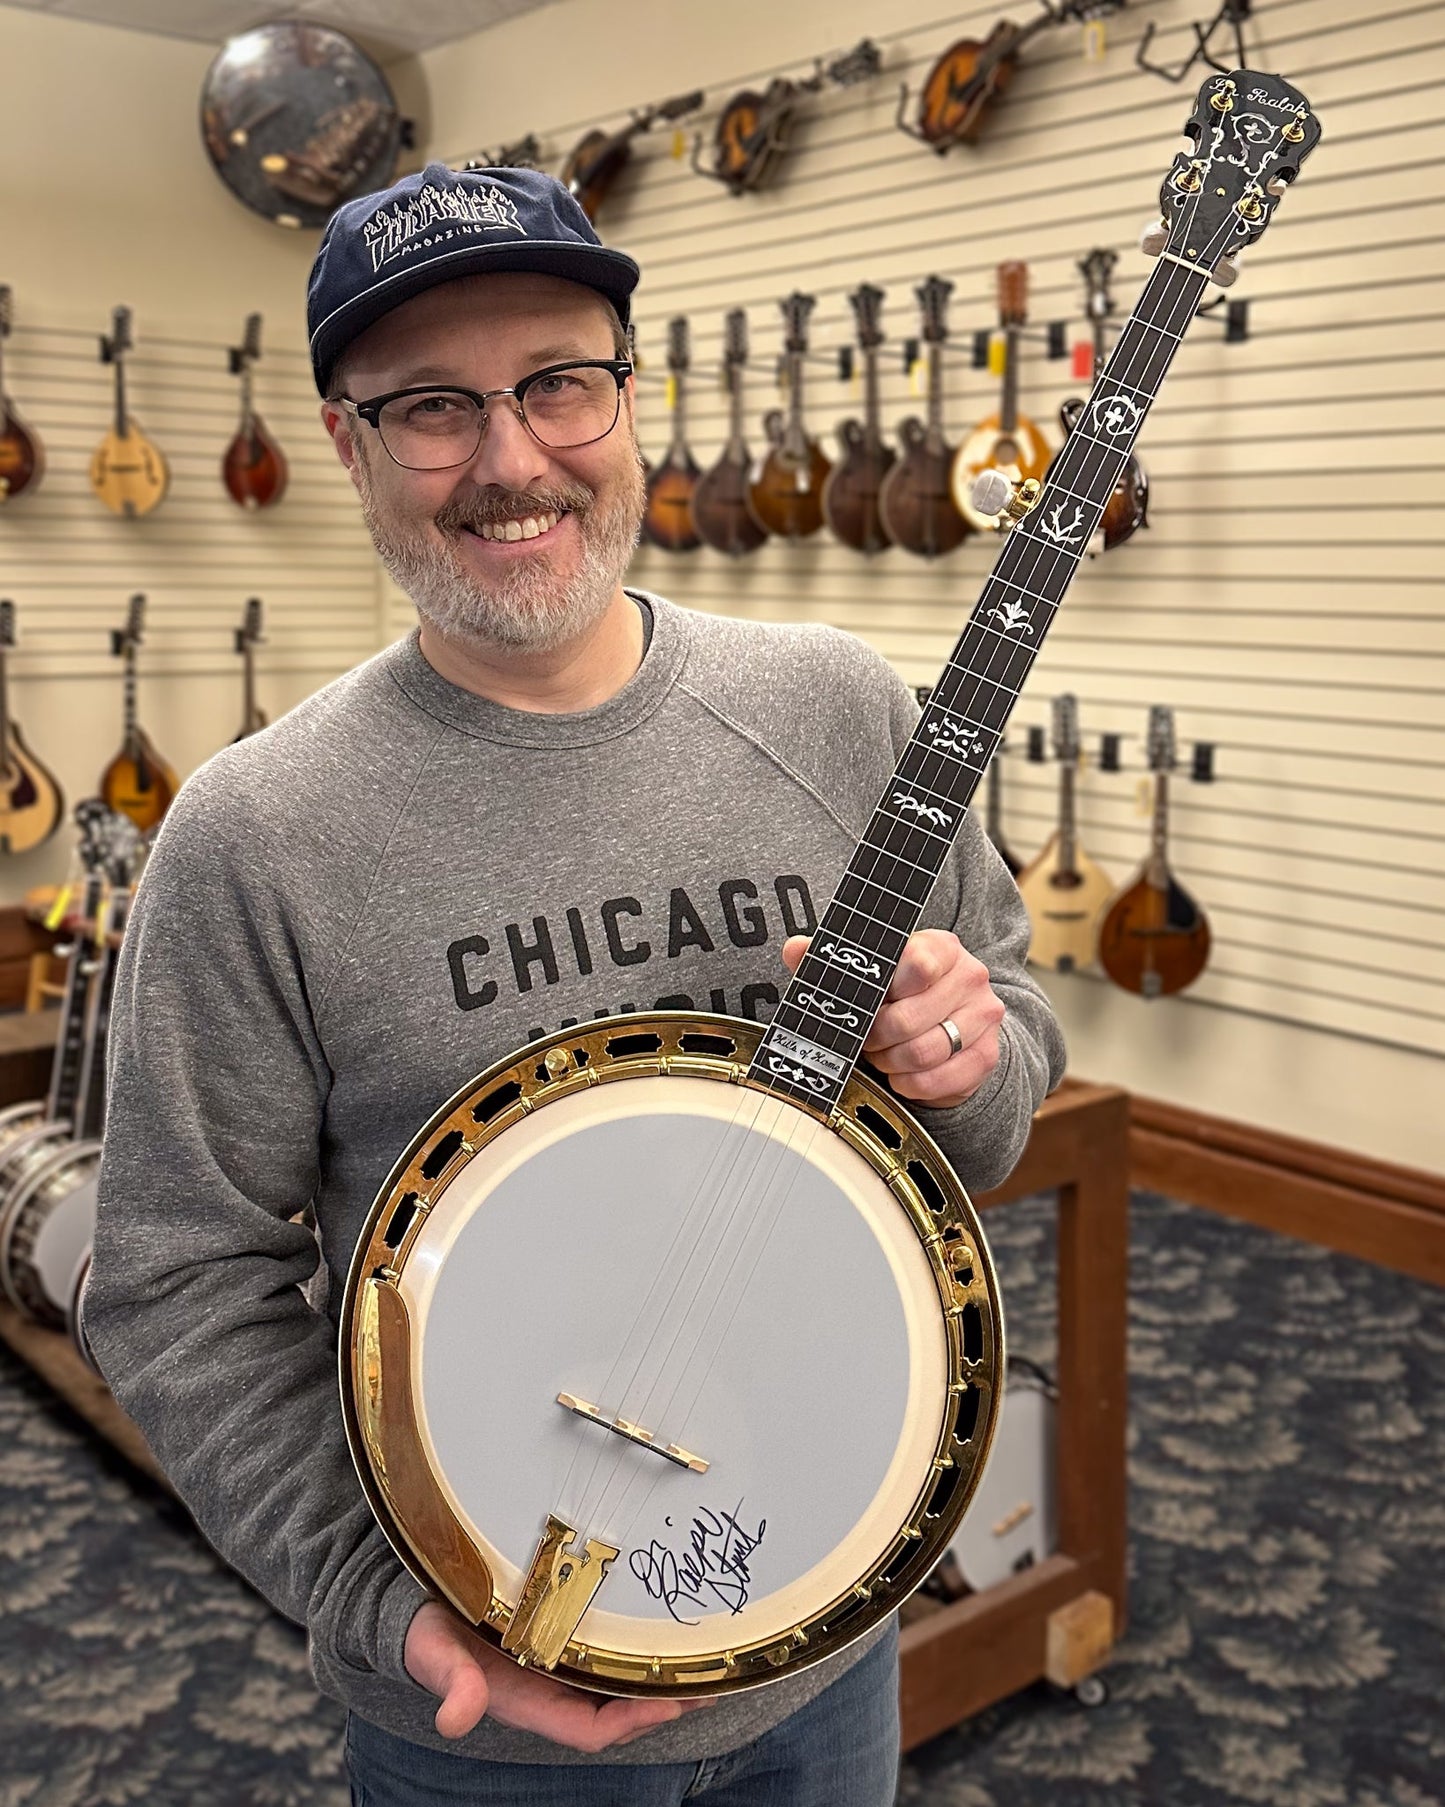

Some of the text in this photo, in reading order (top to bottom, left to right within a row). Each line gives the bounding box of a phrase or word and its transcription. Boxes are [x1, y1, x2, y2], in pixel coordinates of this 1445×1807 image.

[1246, 87, 1310, 117] Ralph
[363, 182, 528, 273] THRASHER
[400, 225, 483, 256] MAGAZINE
[446, 874, 818, 1012] CHICAGO
[772, 1033, 841, 1072] Hills of Home
